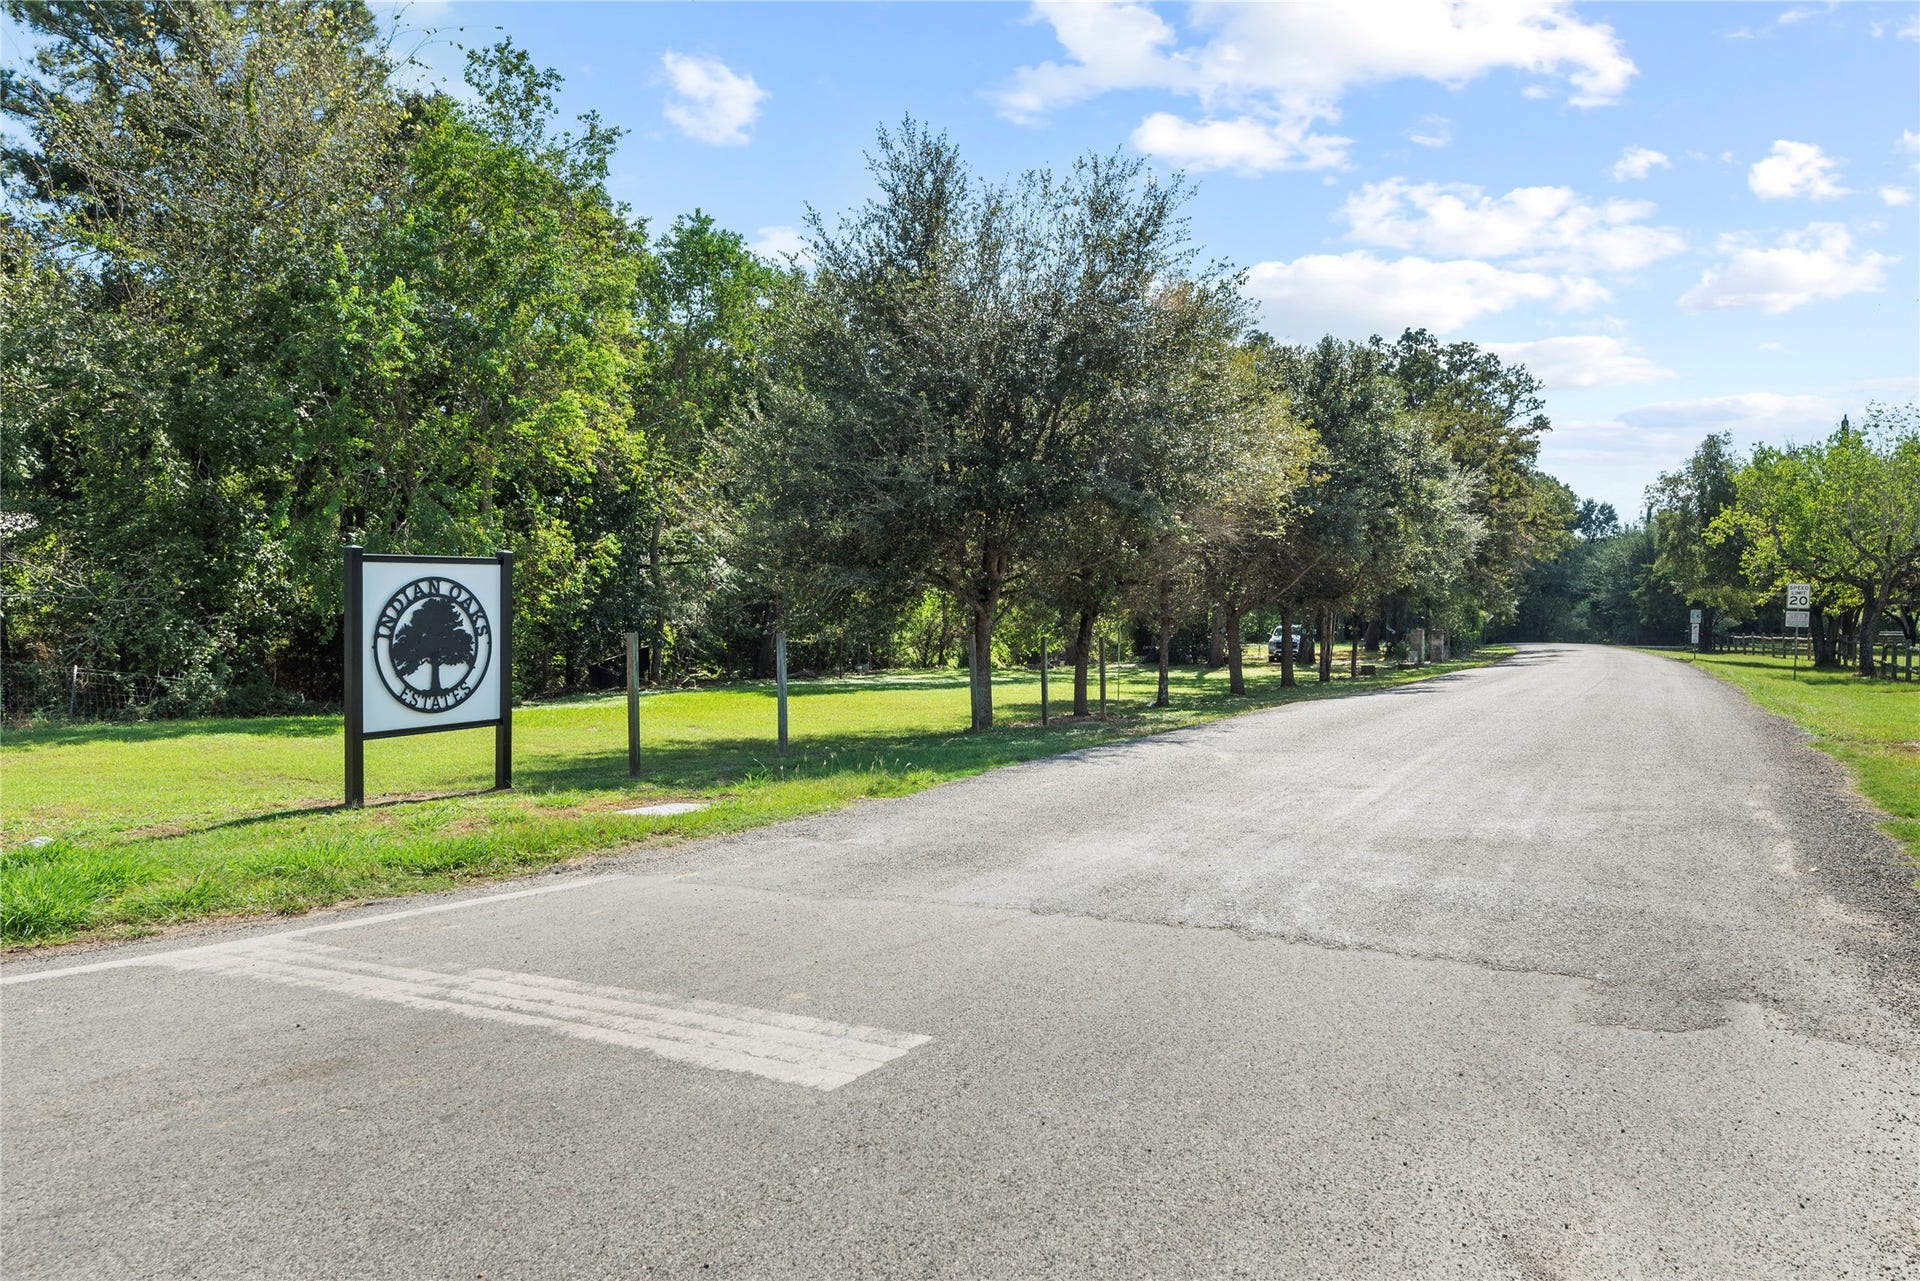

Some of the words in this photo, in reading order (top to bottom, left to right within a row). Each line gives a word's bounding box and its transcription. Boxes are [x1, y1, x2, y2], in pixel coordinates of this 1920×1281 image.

[378, 580, 441, 639] INDIAN
[449, 583, 489, 637] OAKS
[1789, 595, 1808, 606] 20
[401, 682, 472, 711] ESTATES
